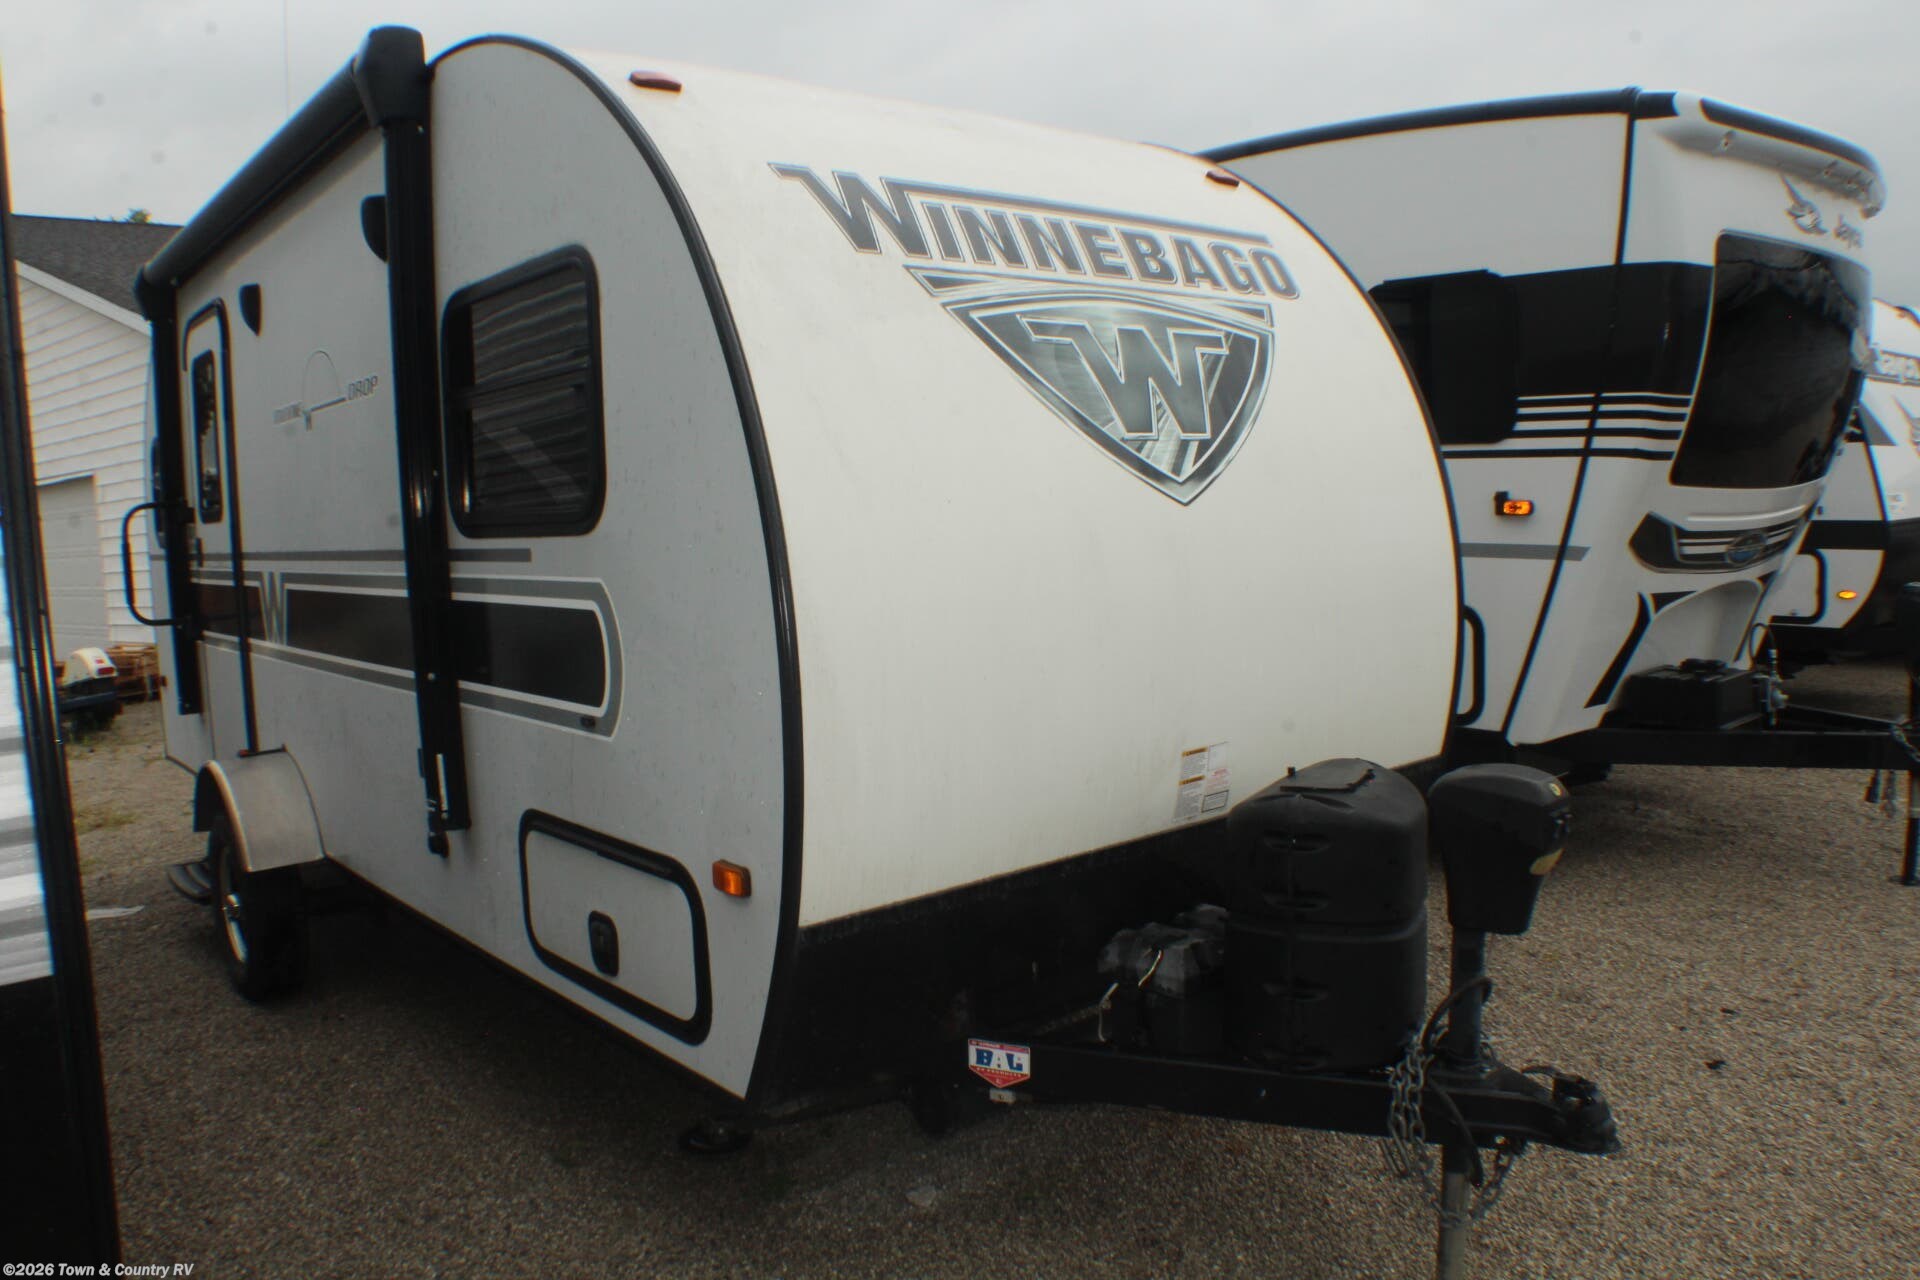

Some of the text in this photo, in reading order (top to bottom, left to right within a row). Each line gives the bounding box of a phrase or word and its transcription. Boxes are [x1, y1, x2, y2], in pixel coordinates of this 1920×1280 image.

[768, 162, 1301, 300] WINNEBAGO
[347, 375, 379, 400] DROP
[1016, 313, 1230, 441] W
[975, 1047, 1024, 1072] BAL
